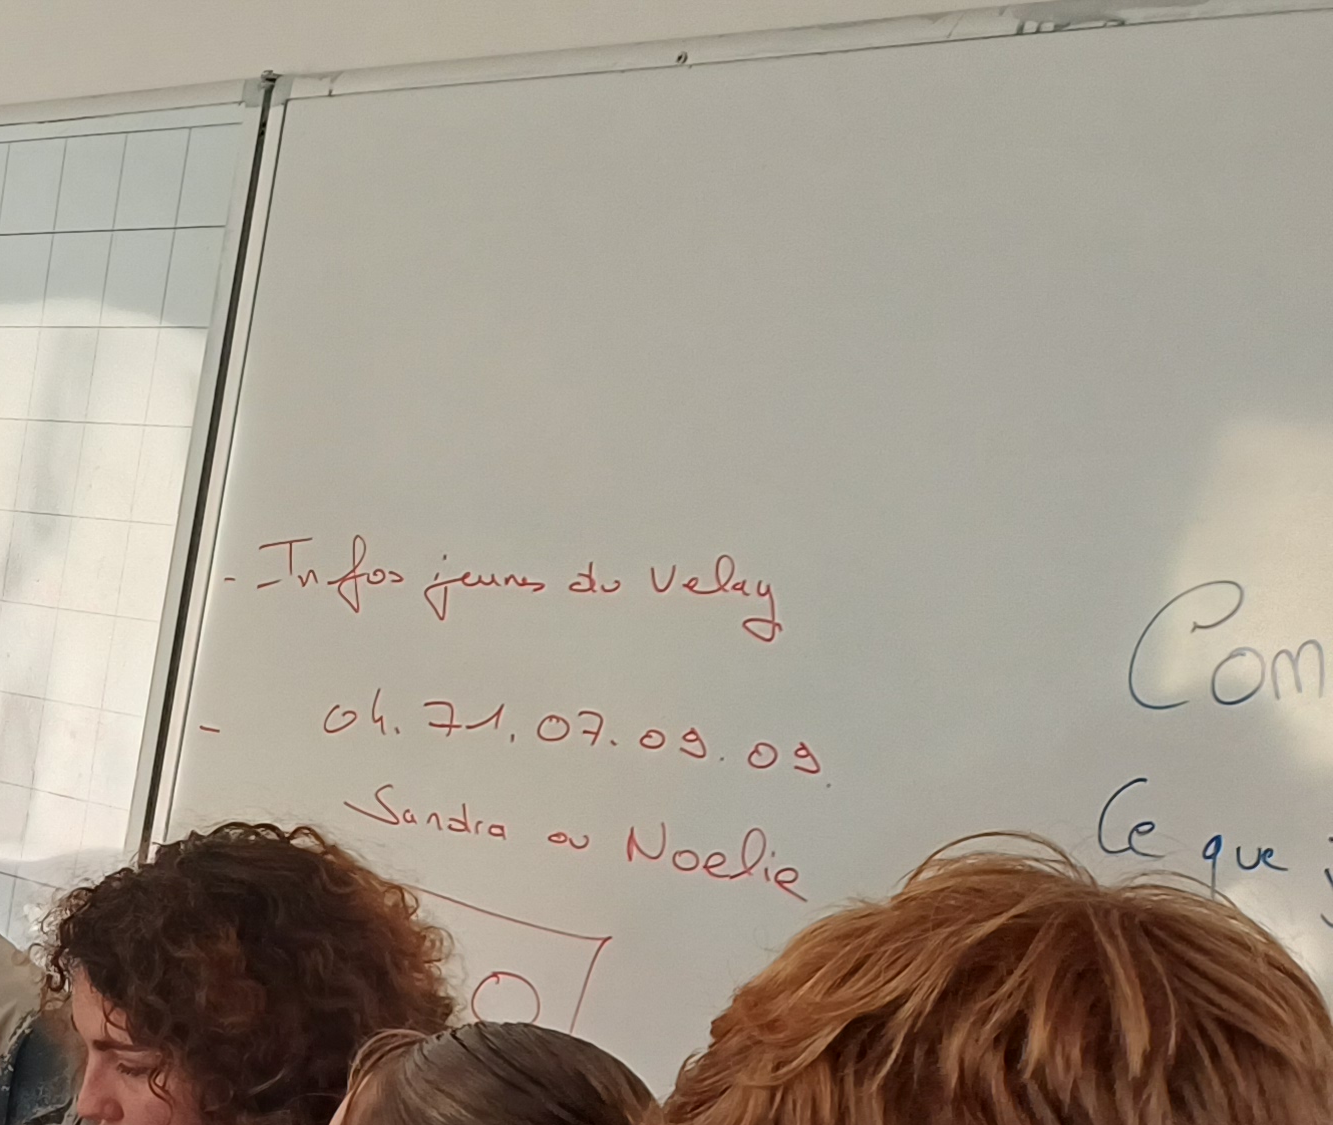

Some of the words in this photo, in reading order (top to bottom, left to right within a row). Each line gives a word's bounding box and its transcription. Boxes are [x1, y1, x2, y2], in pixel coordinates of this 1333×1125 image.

[650, 555, 783, 644] Velay
[343, 784, 508, 840] Sandra
[1097, 776, 1166, 859] Ce
[1201, 833, 1289, 900] que
